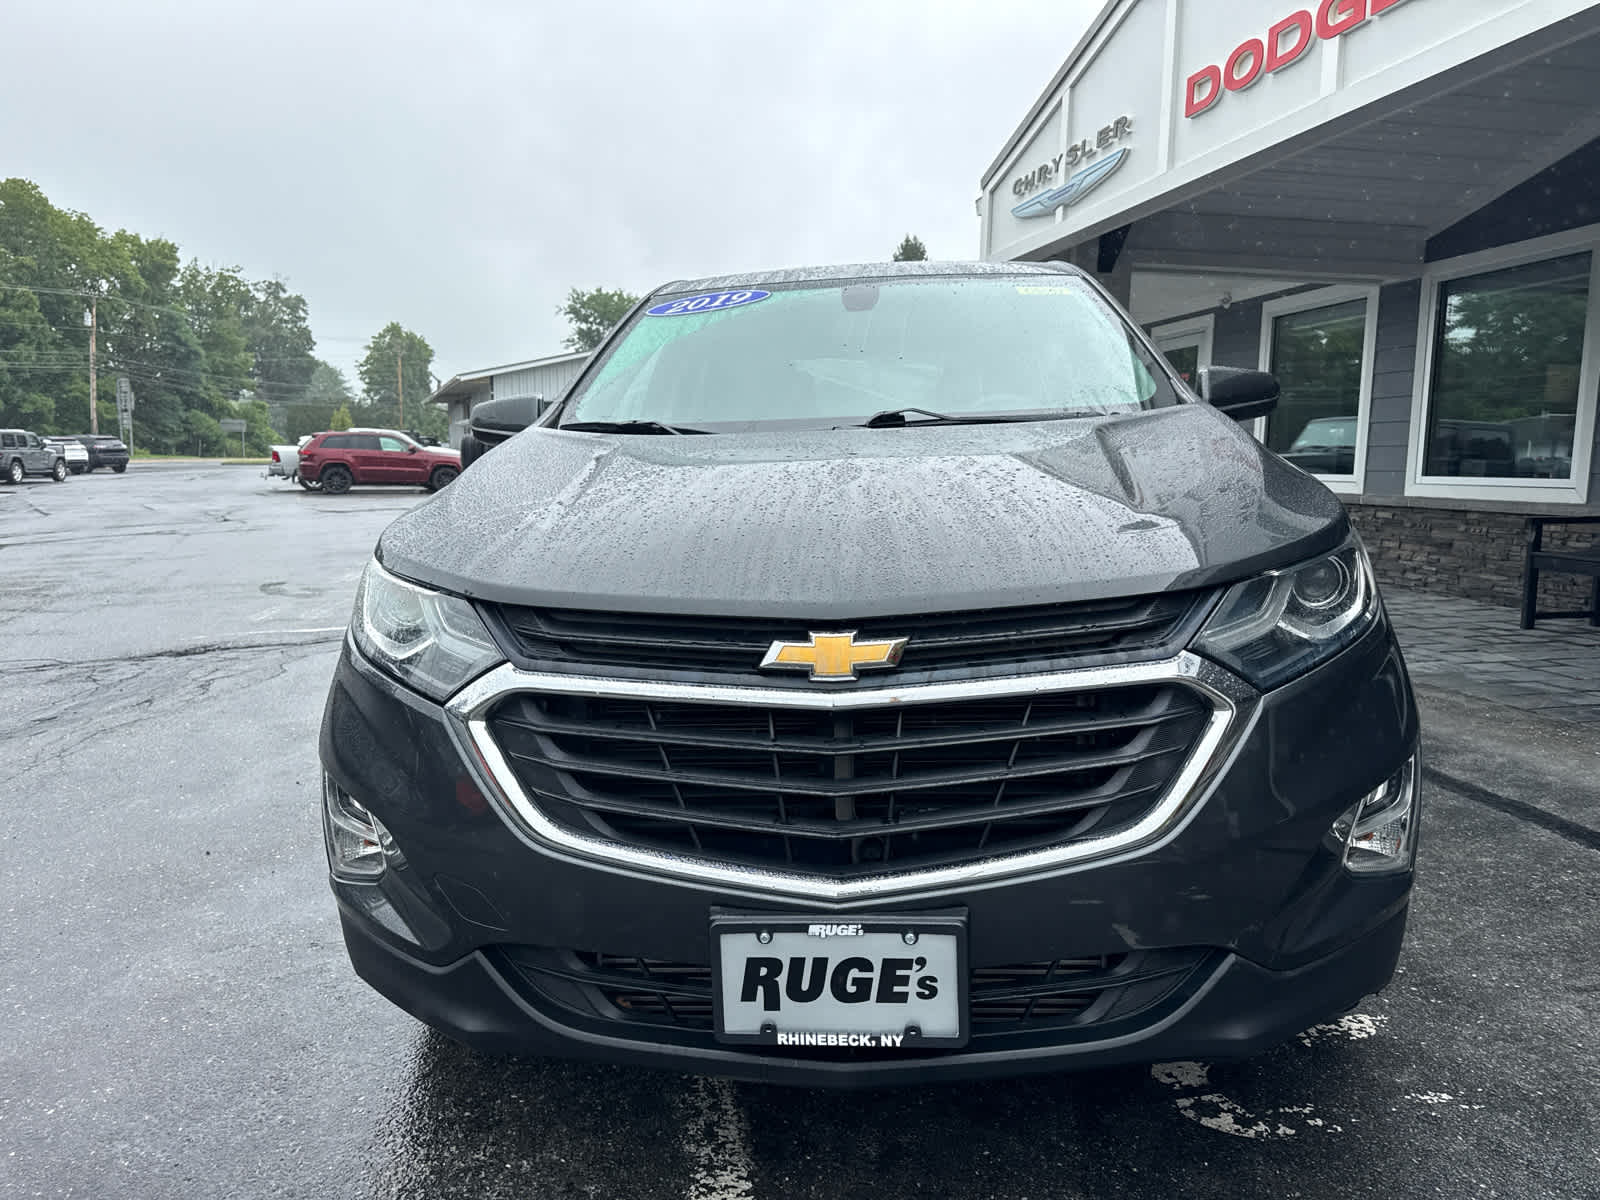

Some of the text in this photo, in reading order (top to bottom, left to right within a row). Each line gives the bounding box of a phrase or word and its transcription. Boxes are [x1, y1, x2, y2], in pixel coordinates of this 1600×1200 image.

[1185, 0, 1400, 118] DODG
[1012, 116, 1132, 195] CHRYSLER
[664, 291, 752, 314] 2019
[740, 956, 938, 1011] RUGE's
[777, 1033, 904, 1047] RHINEBECK, NY
